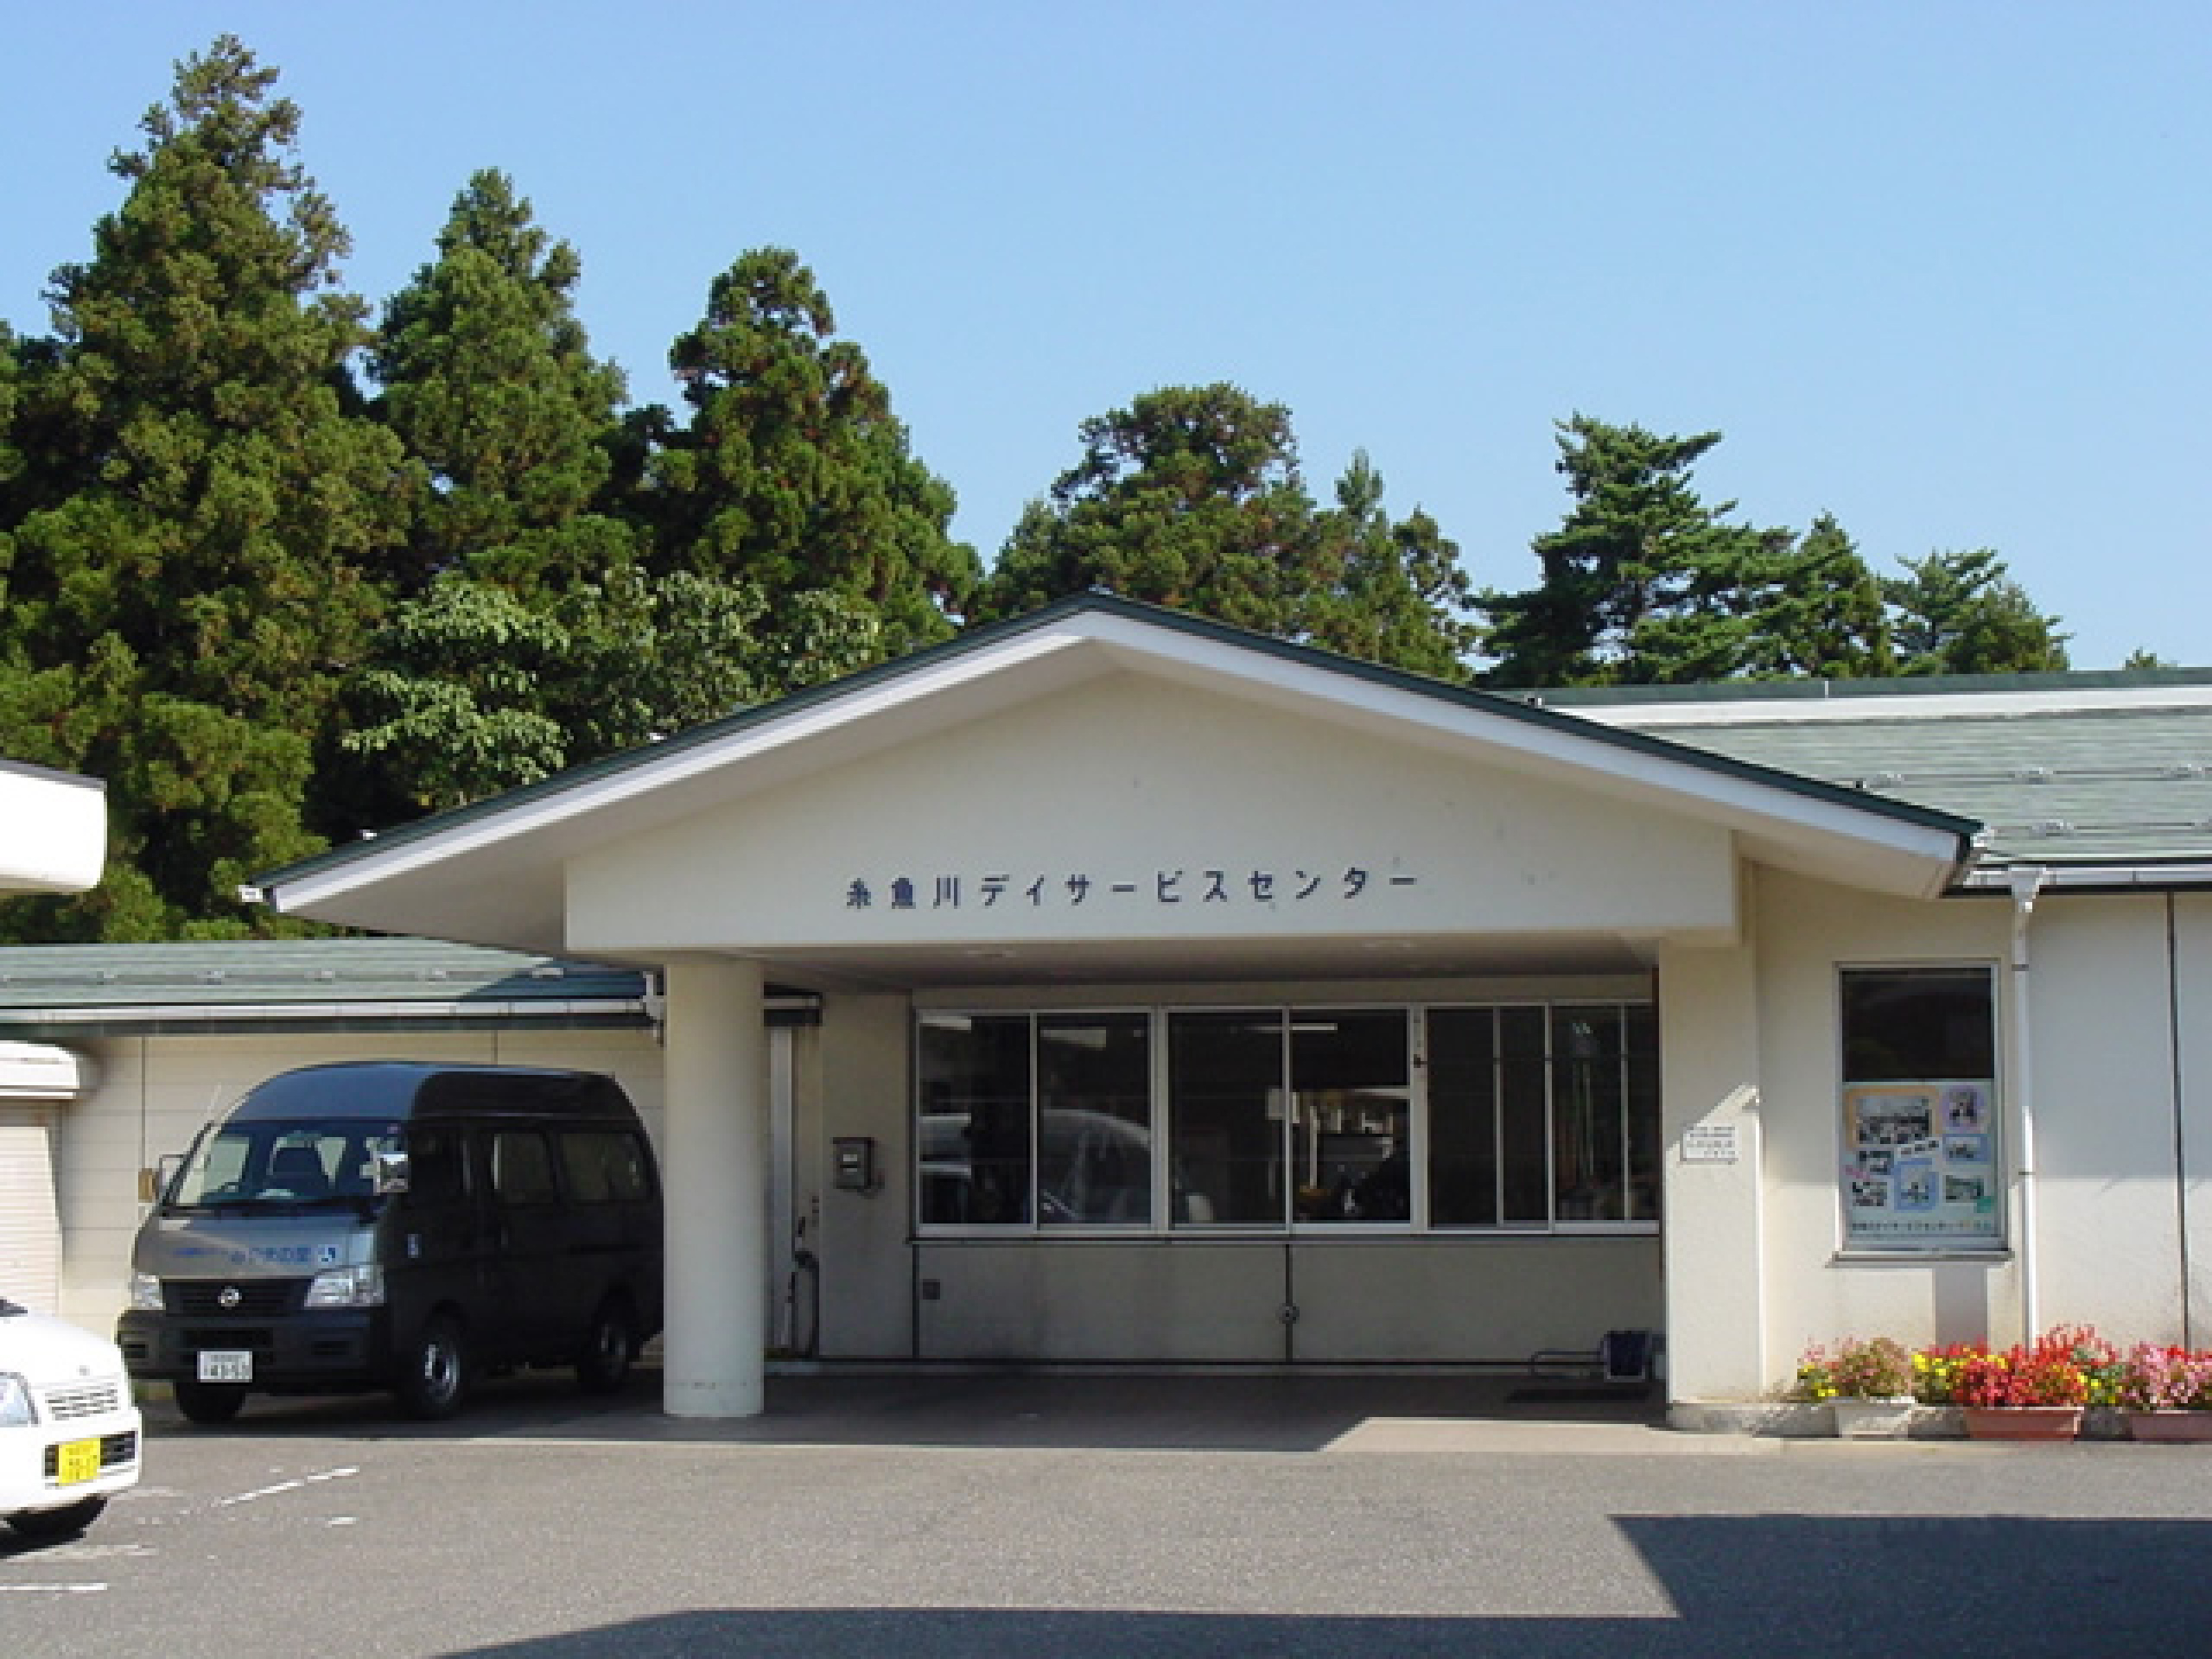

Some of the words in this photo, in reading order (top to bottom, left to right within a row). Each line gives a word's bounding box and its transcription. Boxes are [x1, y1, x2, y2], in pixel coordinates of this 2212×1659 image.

[845, 867, 1417, 909] 糸魚川デイサービスセンター
